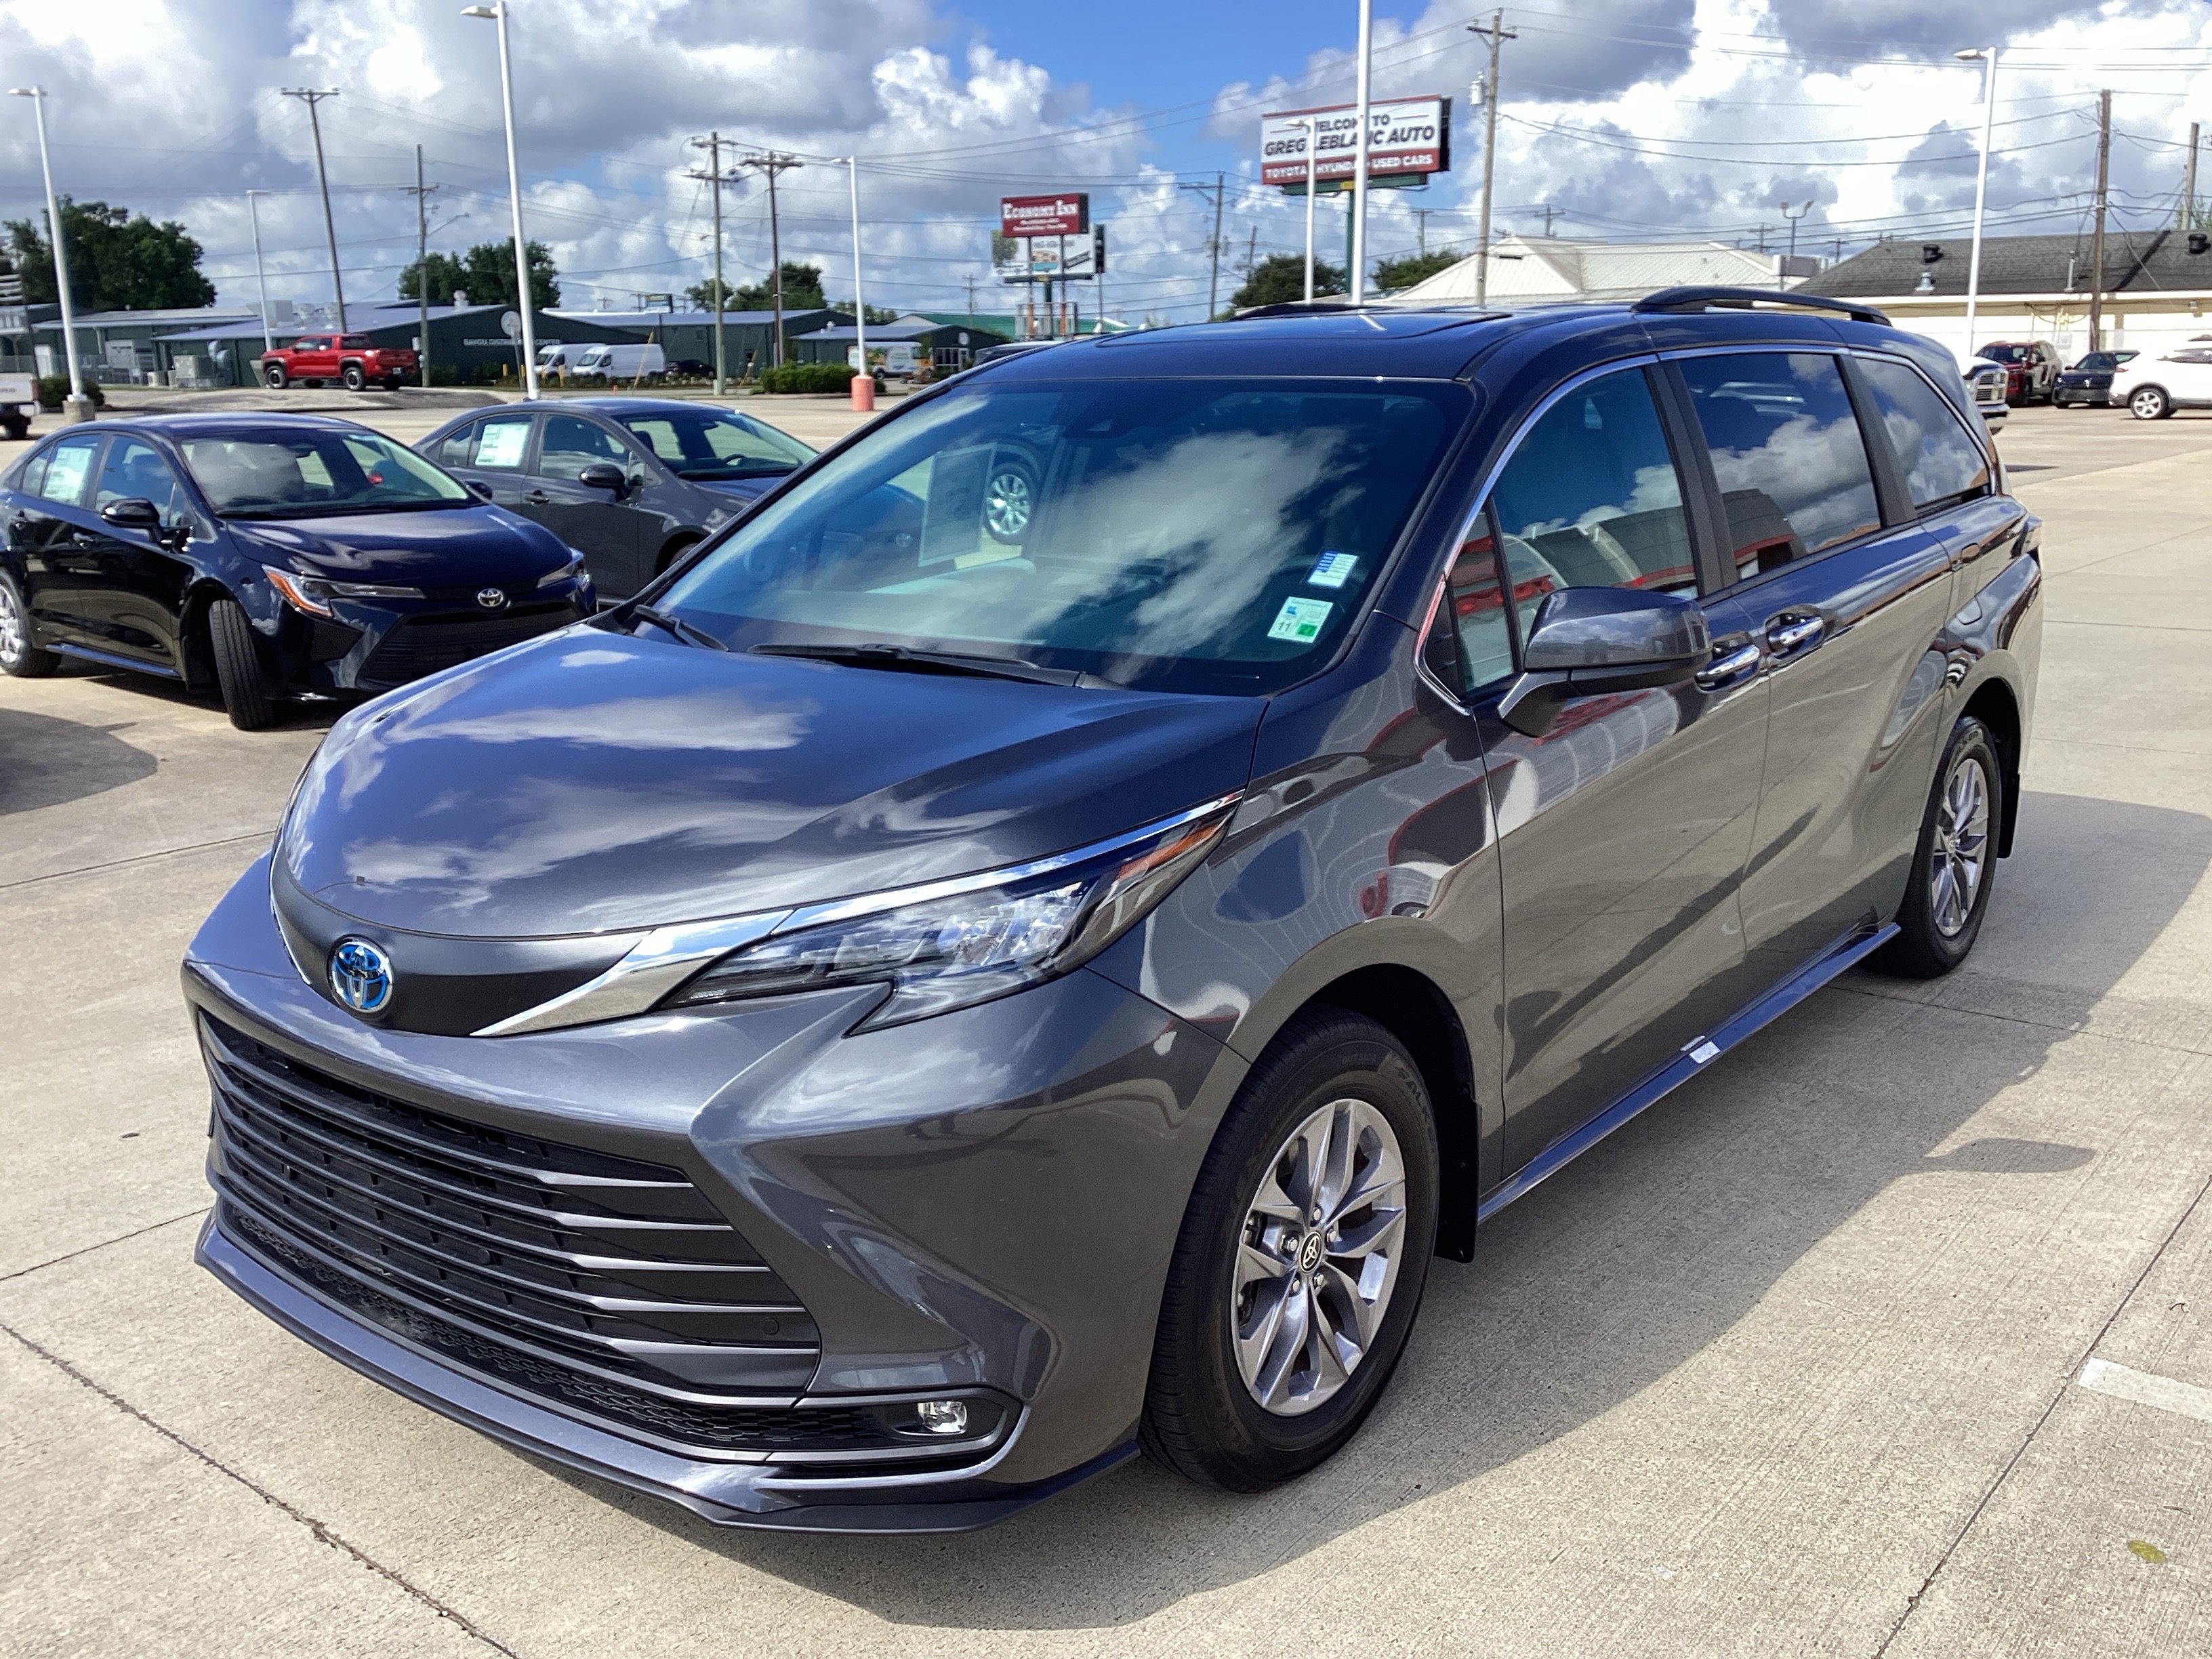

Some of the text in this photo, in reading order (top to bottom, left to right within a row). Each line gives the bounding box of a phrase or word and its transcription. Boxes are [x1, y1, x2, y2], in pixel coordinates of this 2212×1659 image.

[1371, 113, 1391, 127] TO
[1264, 138, 1307, 155] GREG
[1387, 124, 1435, 143] AUTO
